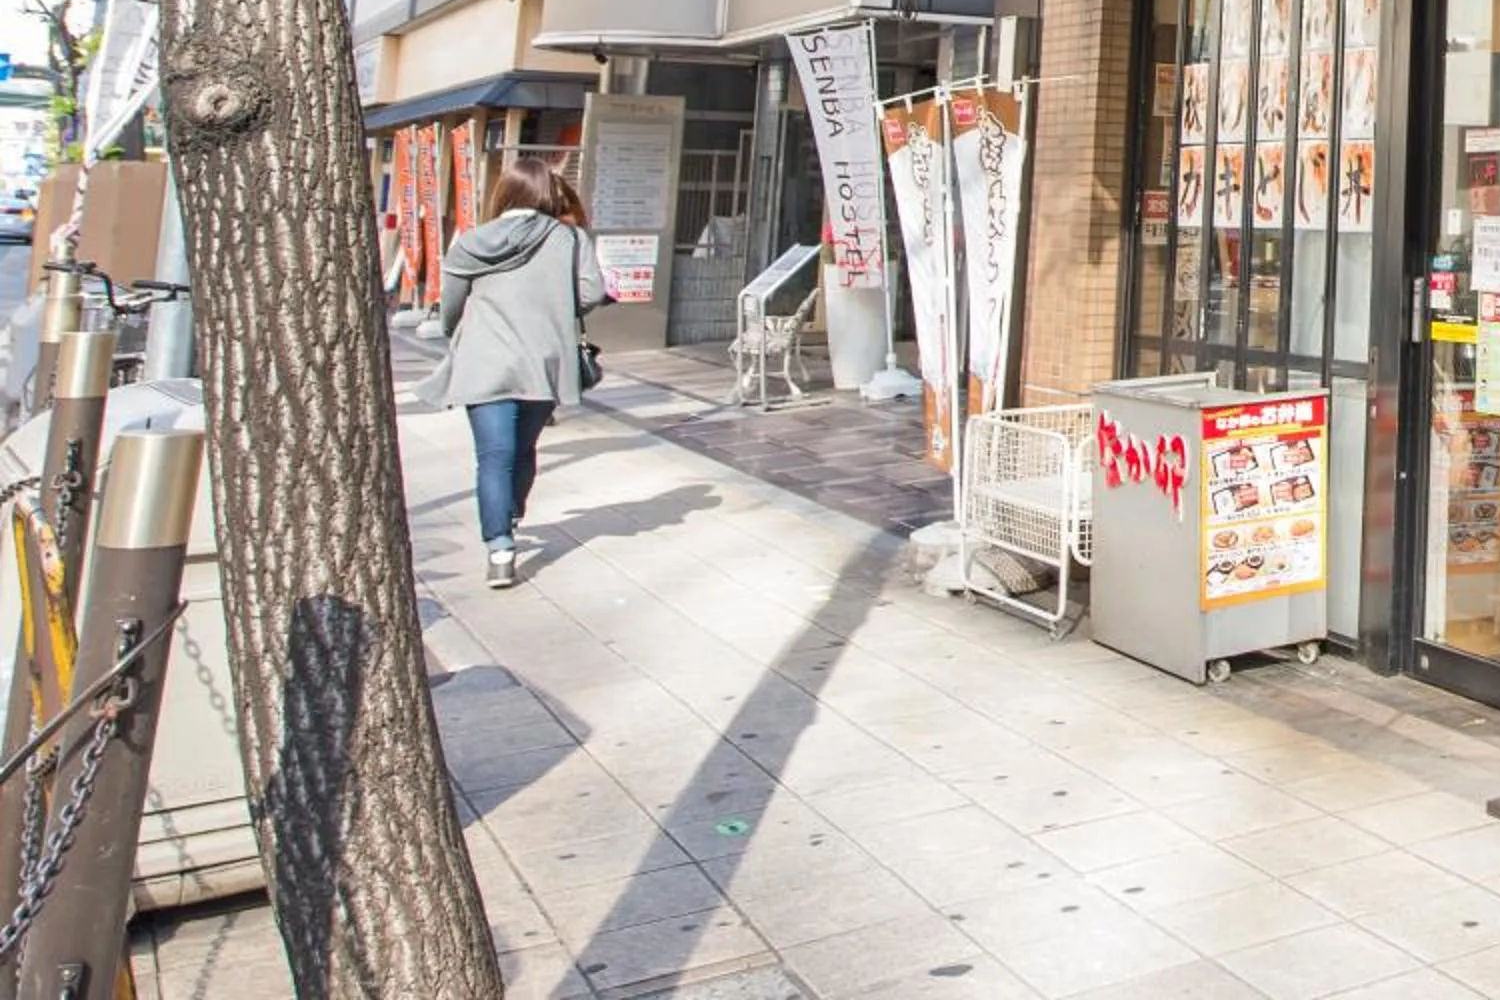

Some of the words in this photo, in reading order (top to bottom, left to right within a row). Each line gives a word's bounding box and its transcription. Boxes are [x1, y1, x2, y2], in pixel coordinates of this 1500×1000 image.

[802, 34, 846, 138] SENBA
[1097, 410, 1189, 521] なか卯
